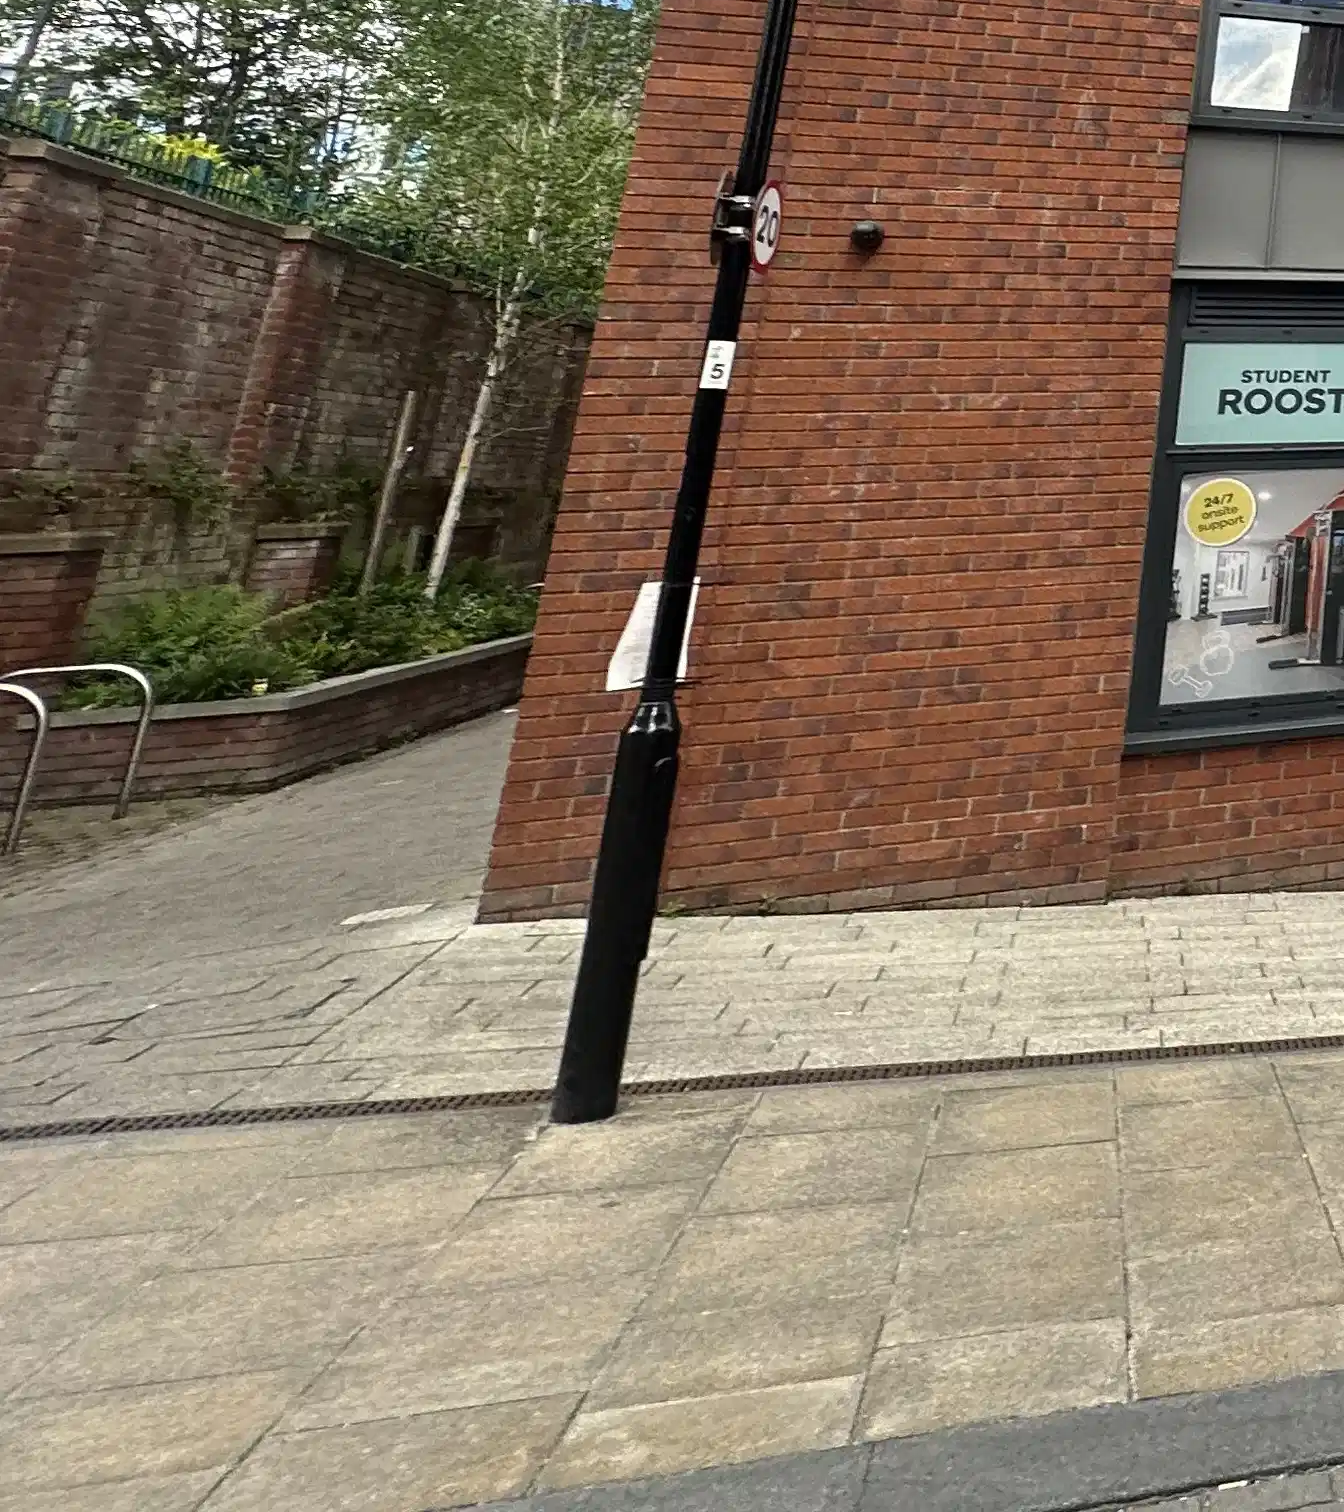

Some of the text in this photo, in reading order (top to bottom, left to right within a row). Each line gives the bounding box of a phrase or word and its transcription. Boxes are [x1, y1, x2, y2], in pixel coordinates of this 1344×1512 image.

[757, 205, 779, 247] 20
[711, 363, 725, 379] 5
[1241, 369, 1331, 384] STUDENT
[1203, 492, 1234, 508] 24/7
[1201, 506, 1240, 520] onsite
[1197, 515, 1245, 532] support
